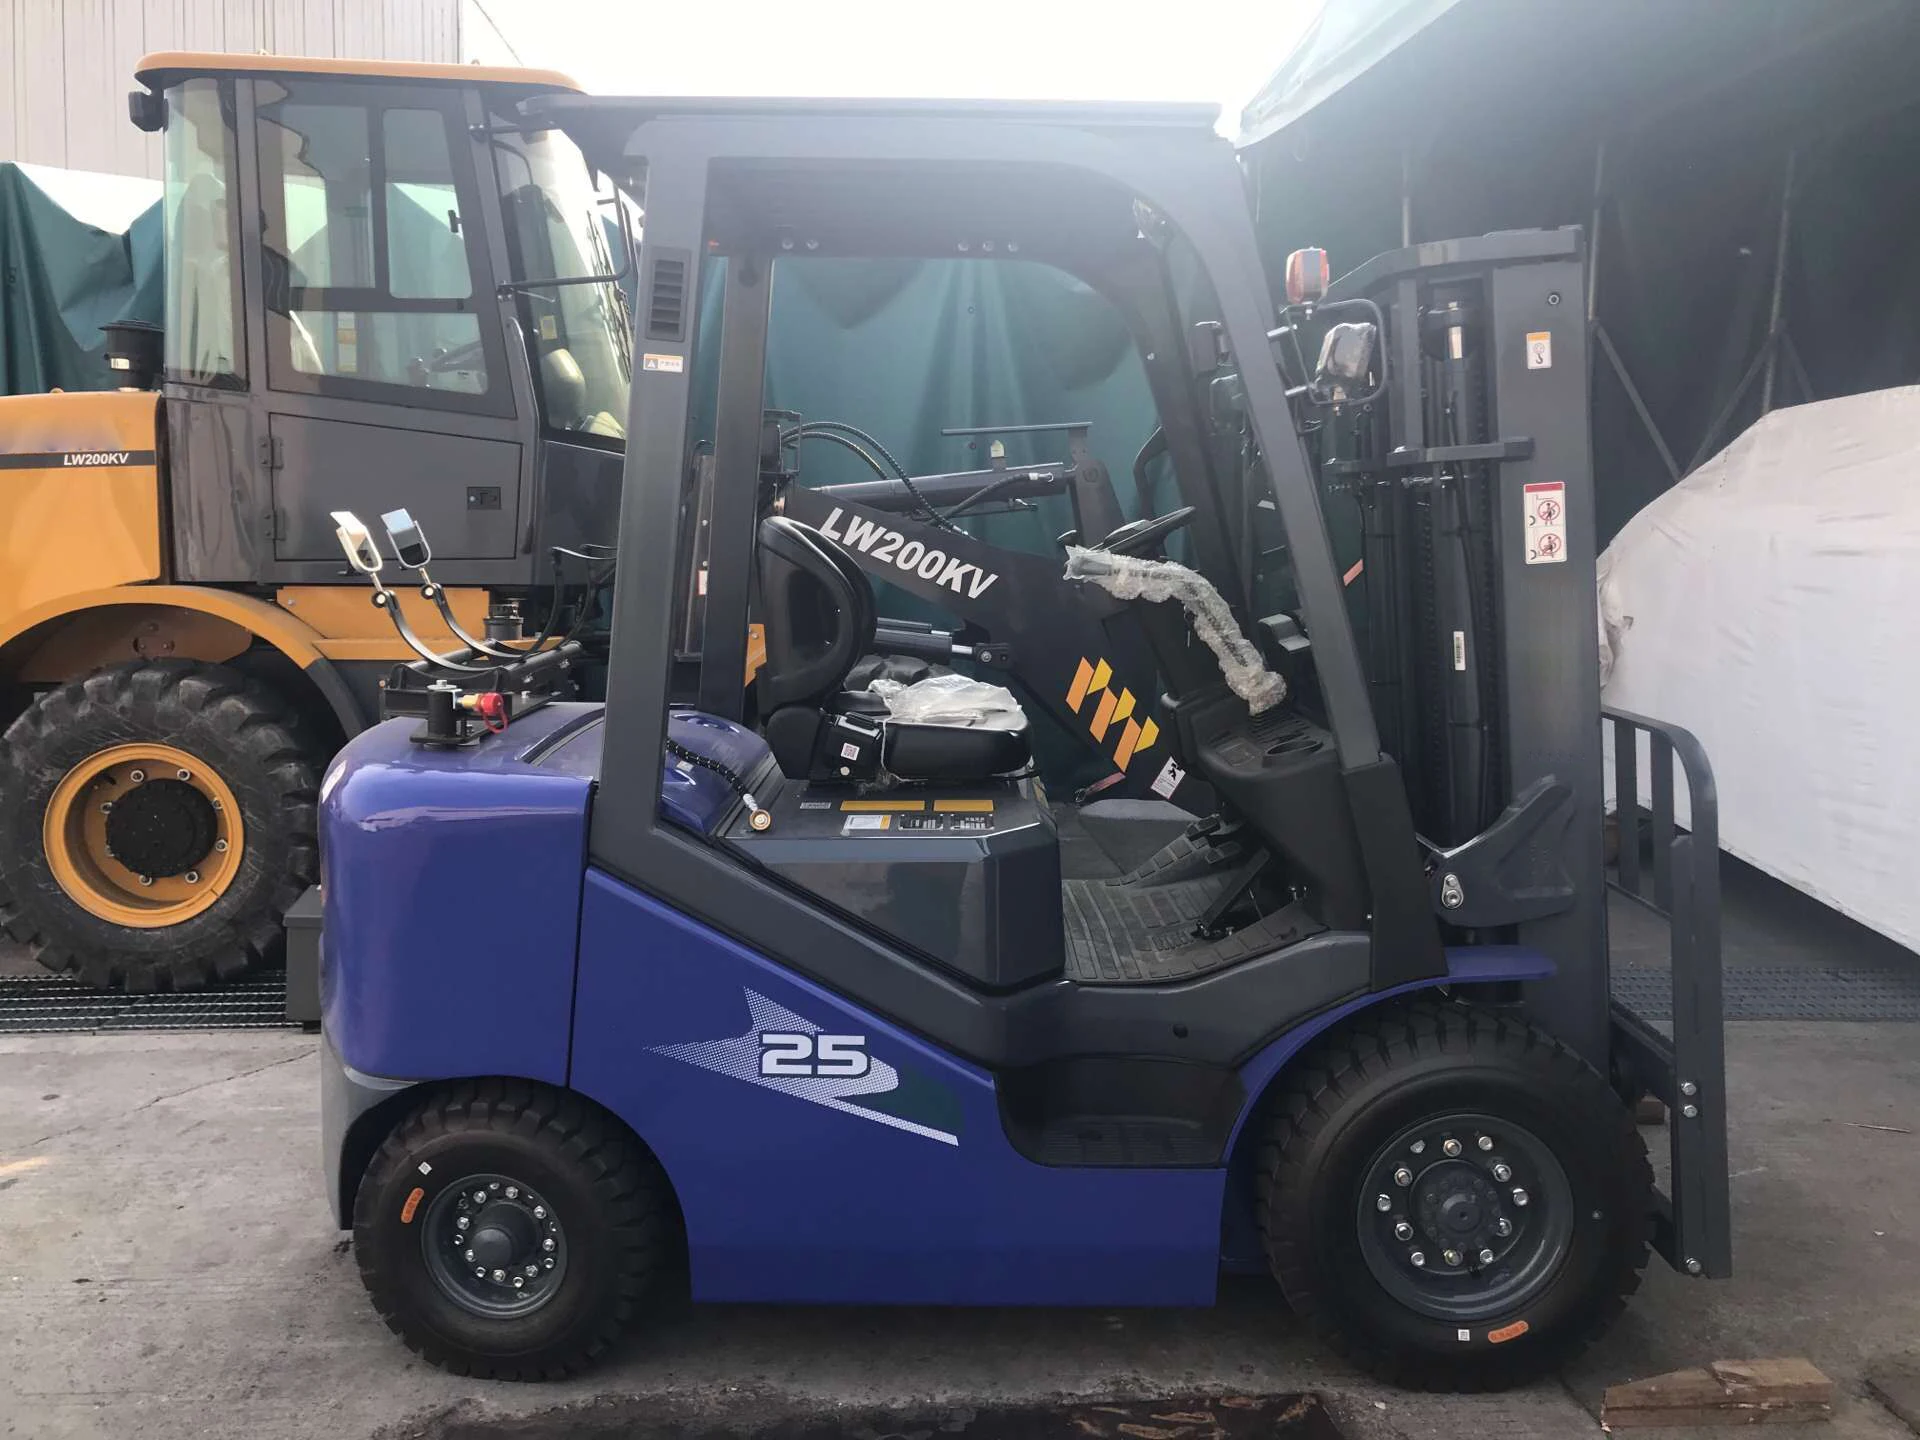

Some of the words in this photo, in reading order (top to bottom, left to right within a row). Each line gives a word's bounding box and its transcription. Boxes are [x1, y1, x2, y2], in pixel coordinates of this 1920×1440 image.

[64, 453, 129, 466] LW200KV
[818, 507, 999, 599] LW200KV
[762, 1034, 868, 1075] 25
